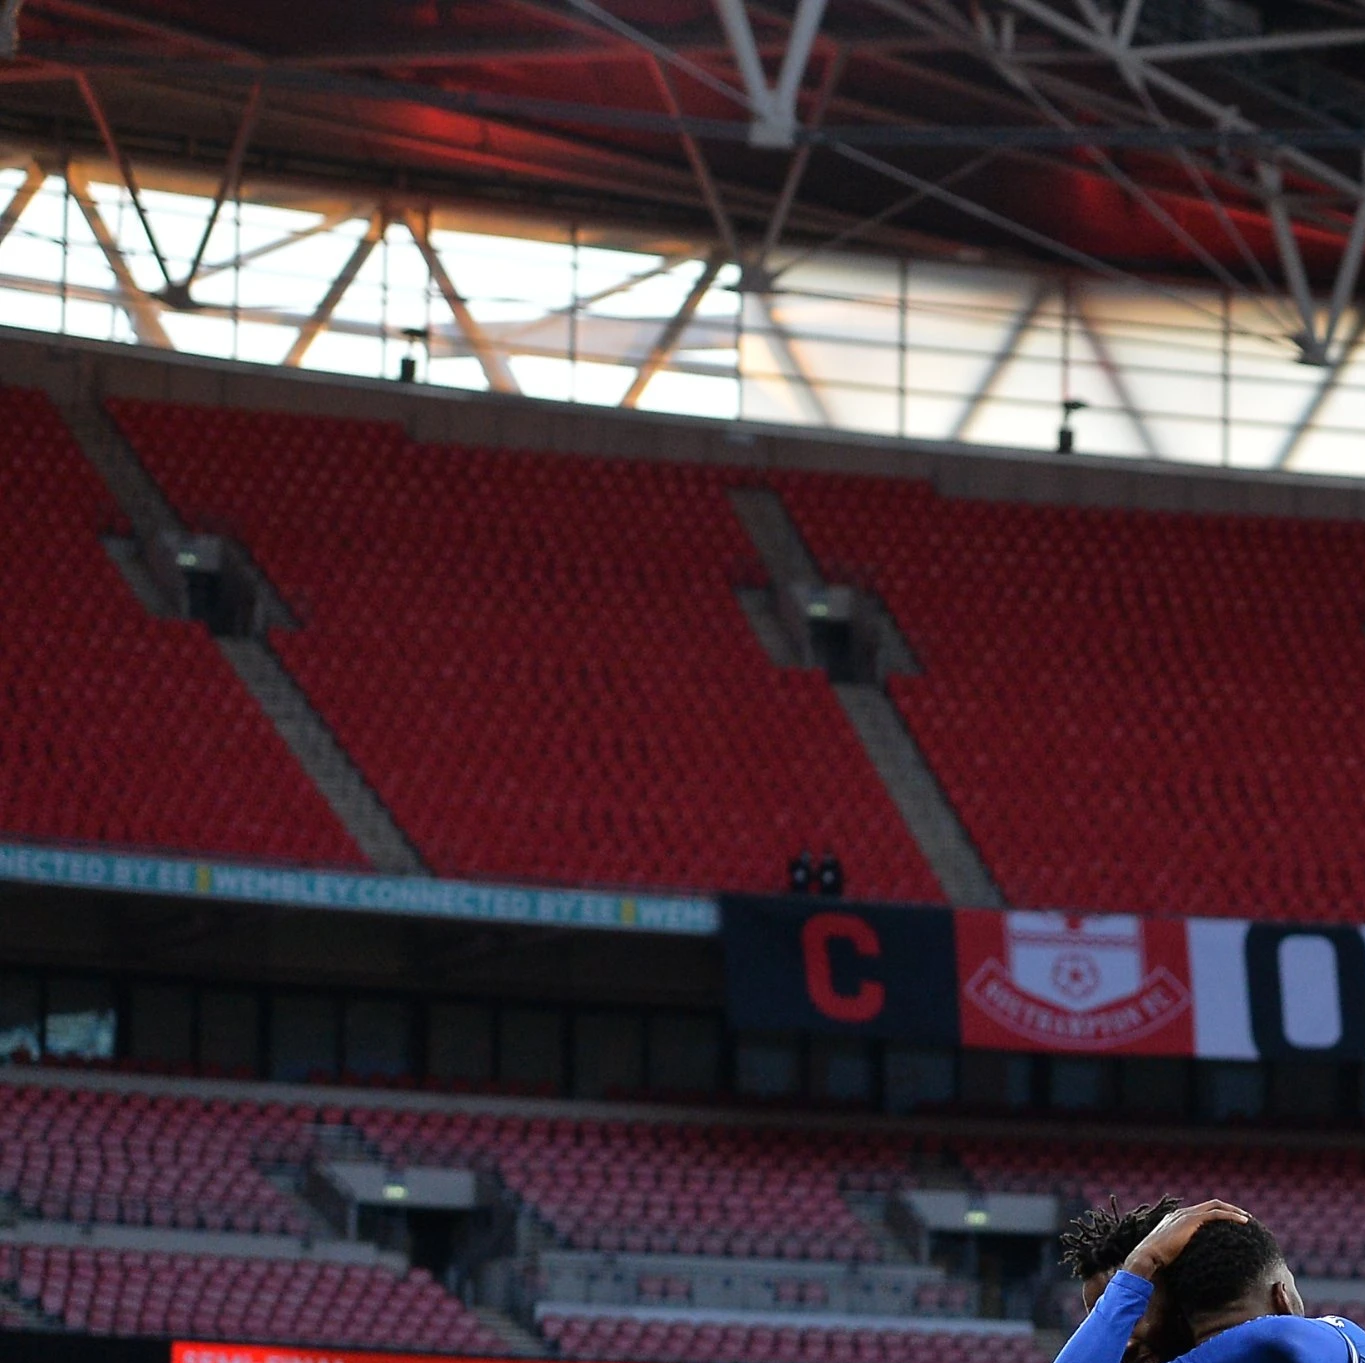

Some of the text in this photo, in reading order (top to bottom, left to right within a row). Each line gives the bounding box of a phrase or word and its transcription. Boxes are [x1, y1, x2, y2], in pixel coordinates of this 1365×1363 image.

[213, 866, 353, 906] WEMBLEY
[358, 879, 532, 917] CONNECTED
[803, 912, 885, 1022] C
